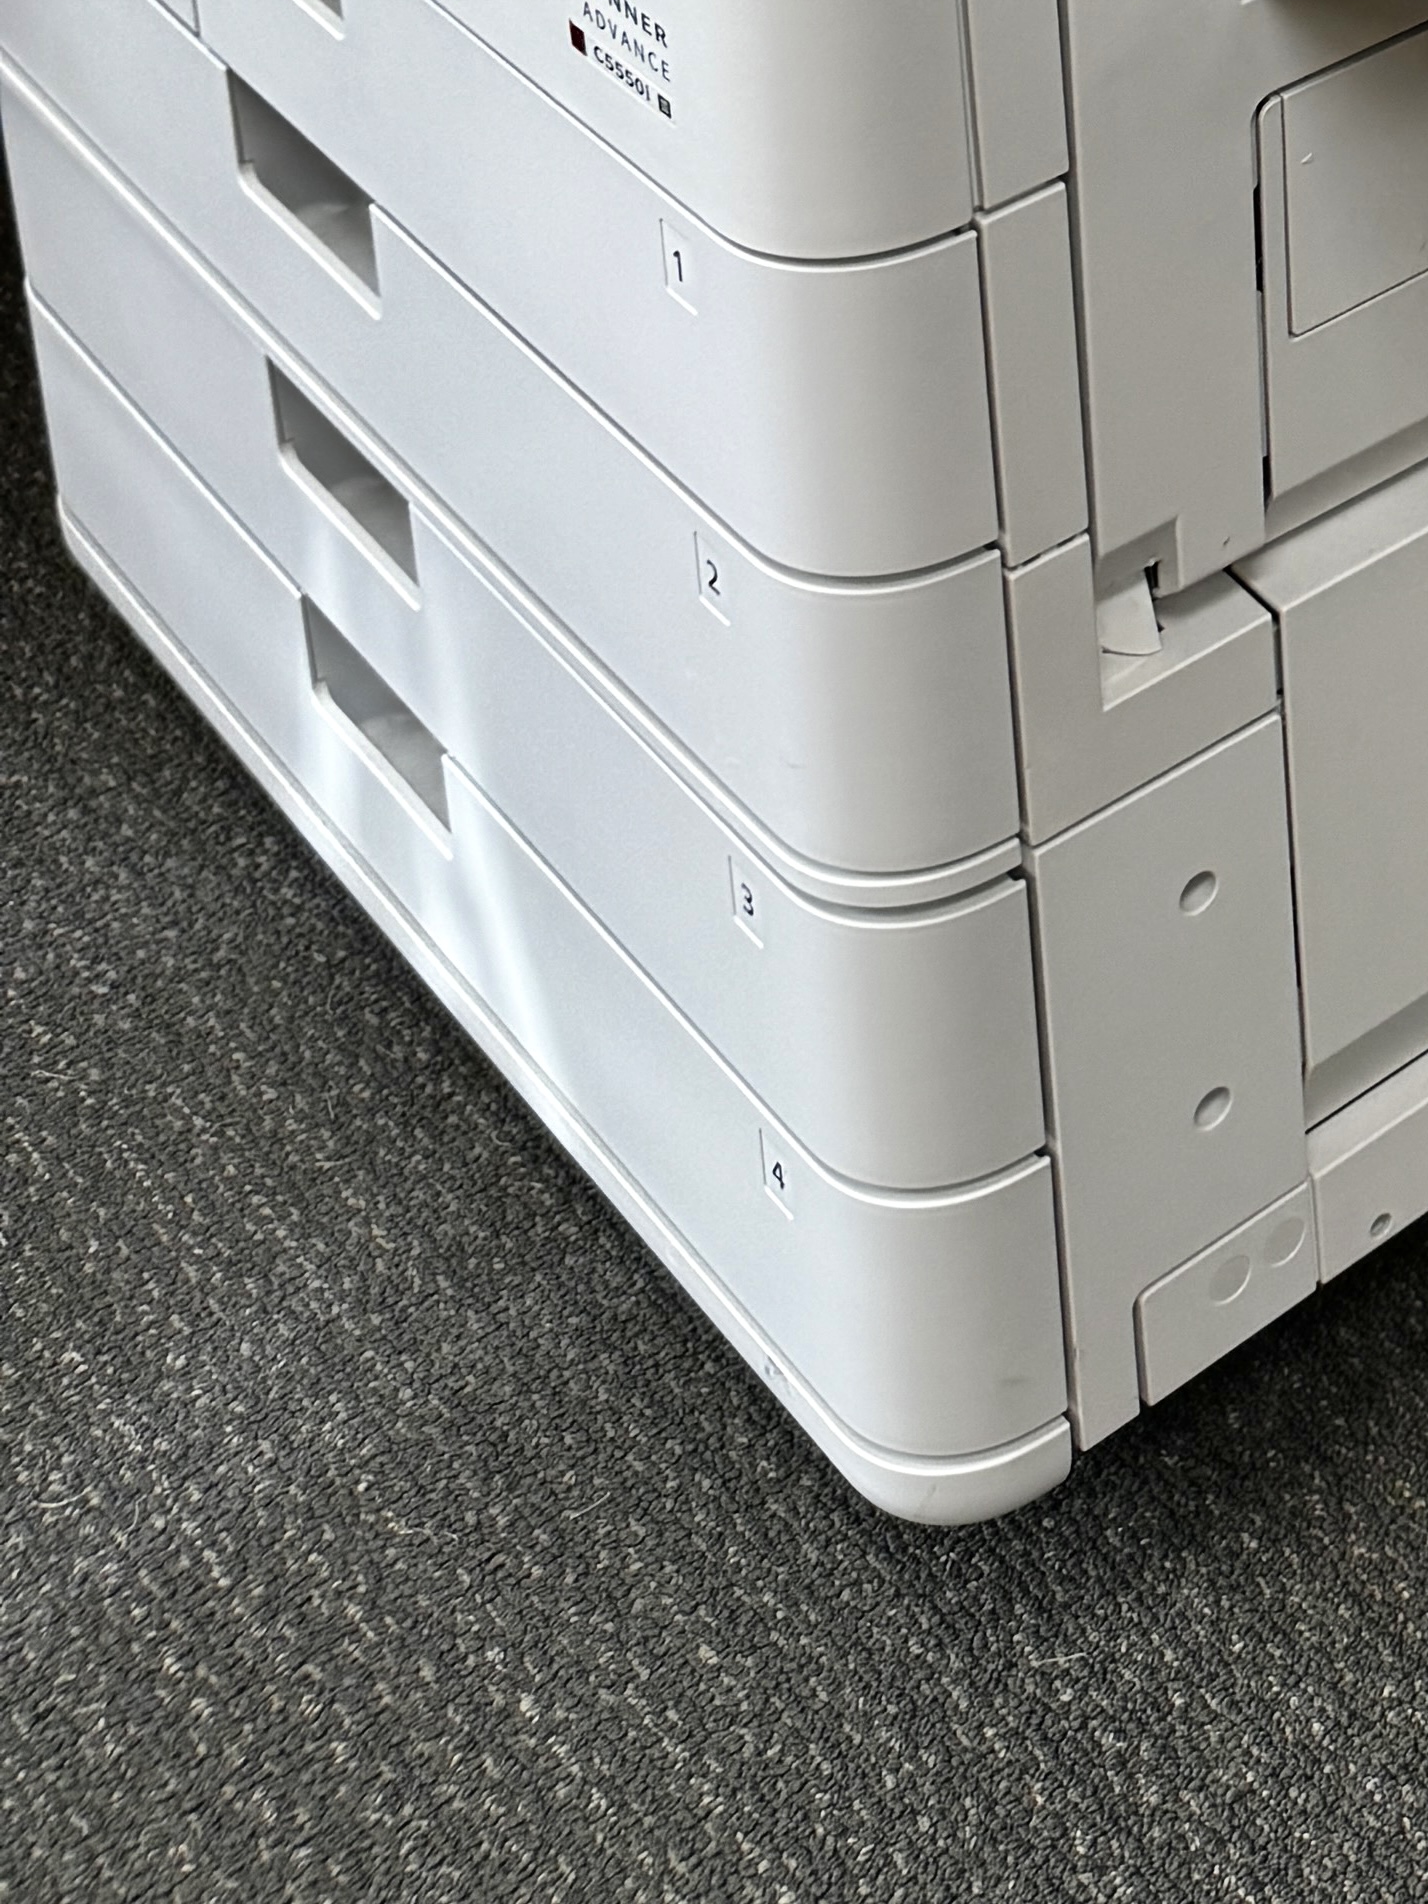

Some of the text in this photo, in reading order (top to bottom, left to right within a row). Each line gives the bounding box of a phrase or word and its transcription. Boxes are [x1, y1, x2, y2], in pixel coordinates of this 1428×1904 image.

[582, 0, 671, 83] ADVANCE
[672, 250, 683, 283] 1
[706, 558, 721, 596] 2
[740, 882, 755, 917] 3
[771, 1161, 786, 1191] 4
